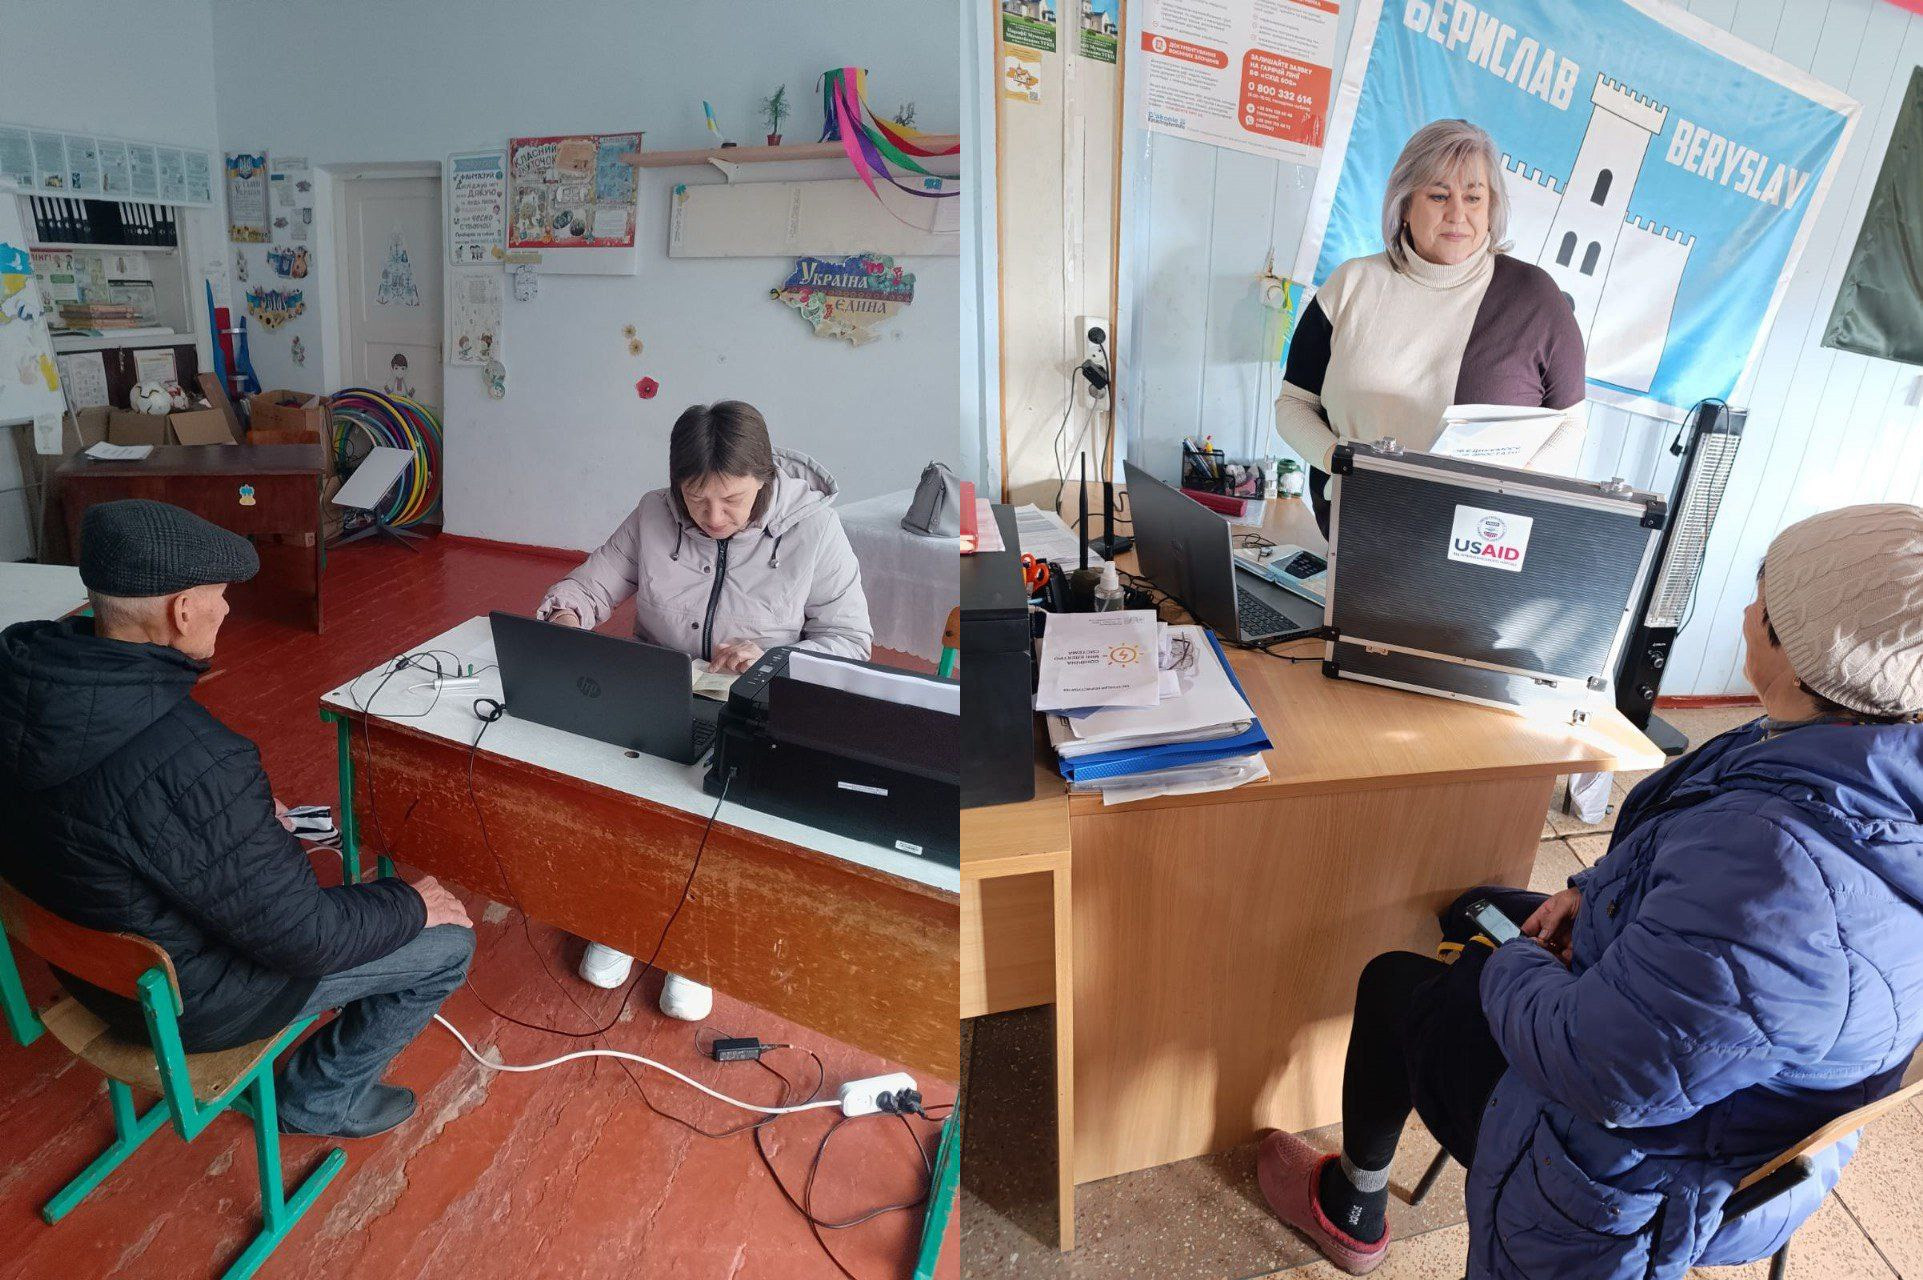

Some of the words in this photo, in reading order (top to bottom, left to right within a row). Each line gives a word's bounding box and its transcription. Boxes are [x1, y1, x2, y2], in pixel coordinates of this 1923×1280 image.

[1250, 54, 1289, 69] ЗАЛИШАЙТЕ
[1403, 0, 1580, 111] БЕРИСЛАВ
[1248, 81, 1255, 91] 0
[1257, 83, 1276, 96] 800
[1278, 89, 1295, 101] 332
[1297, 94, 1313, 105] 614
[514, 144, 557, 168] КЛАСНИЙ
[519, 154, 557, 174] КУТОЧОК
[1665, 118, 1811, 210] BERYSLAV
[1454, 538, 1520, 561] USAID
